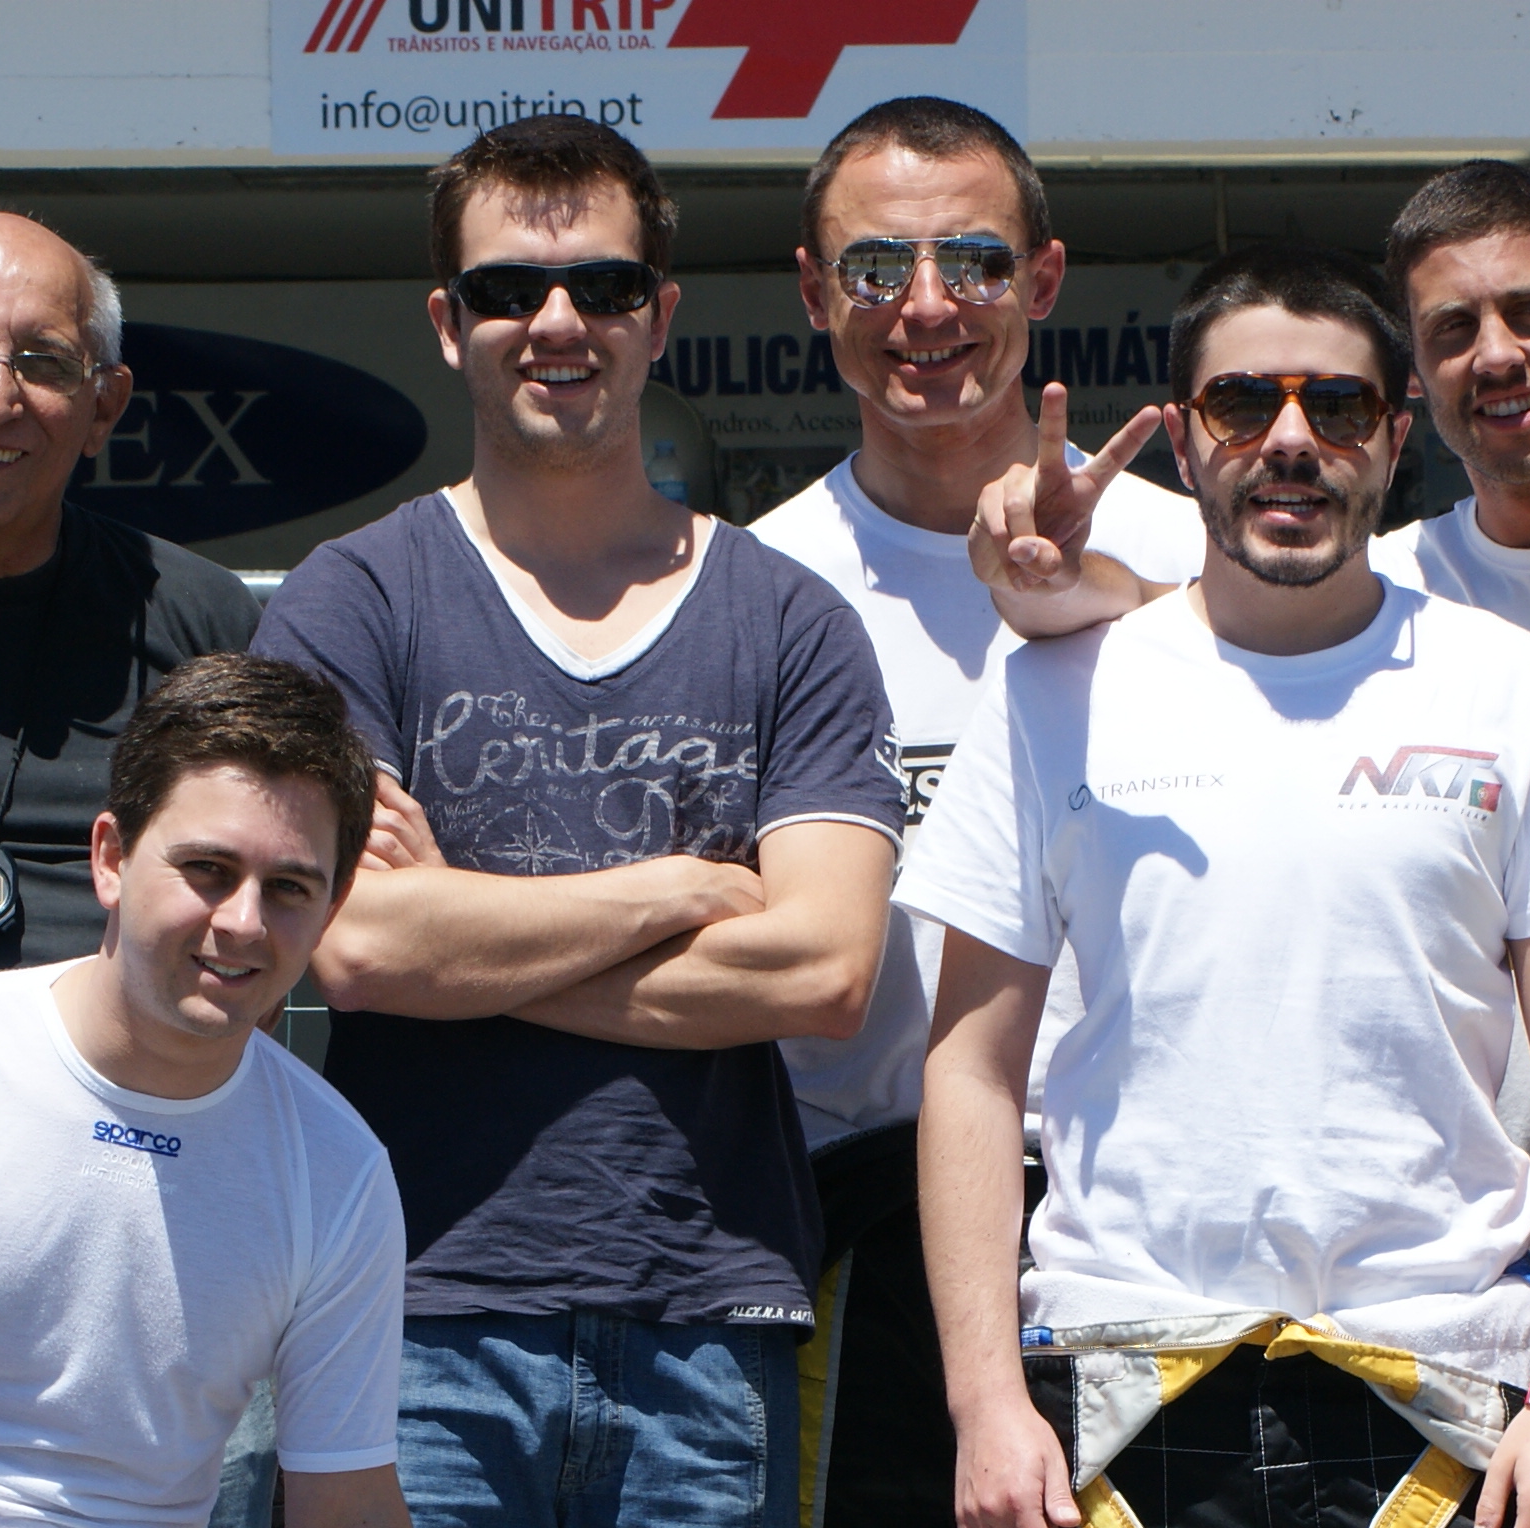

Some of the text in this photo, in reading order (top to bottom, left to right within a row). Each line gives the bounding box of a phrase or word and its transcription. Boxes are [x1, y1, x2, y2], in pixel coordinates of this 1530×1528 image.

[388, 33, 655, 53] TRÂNSITOS E NAVEGAÇÃO, LDA.
[322, 90, 643, 132] info@unitript
[1098, 774, 1224, 800] TRANSITEX
[93, 1121, 181, 1155] sparco
